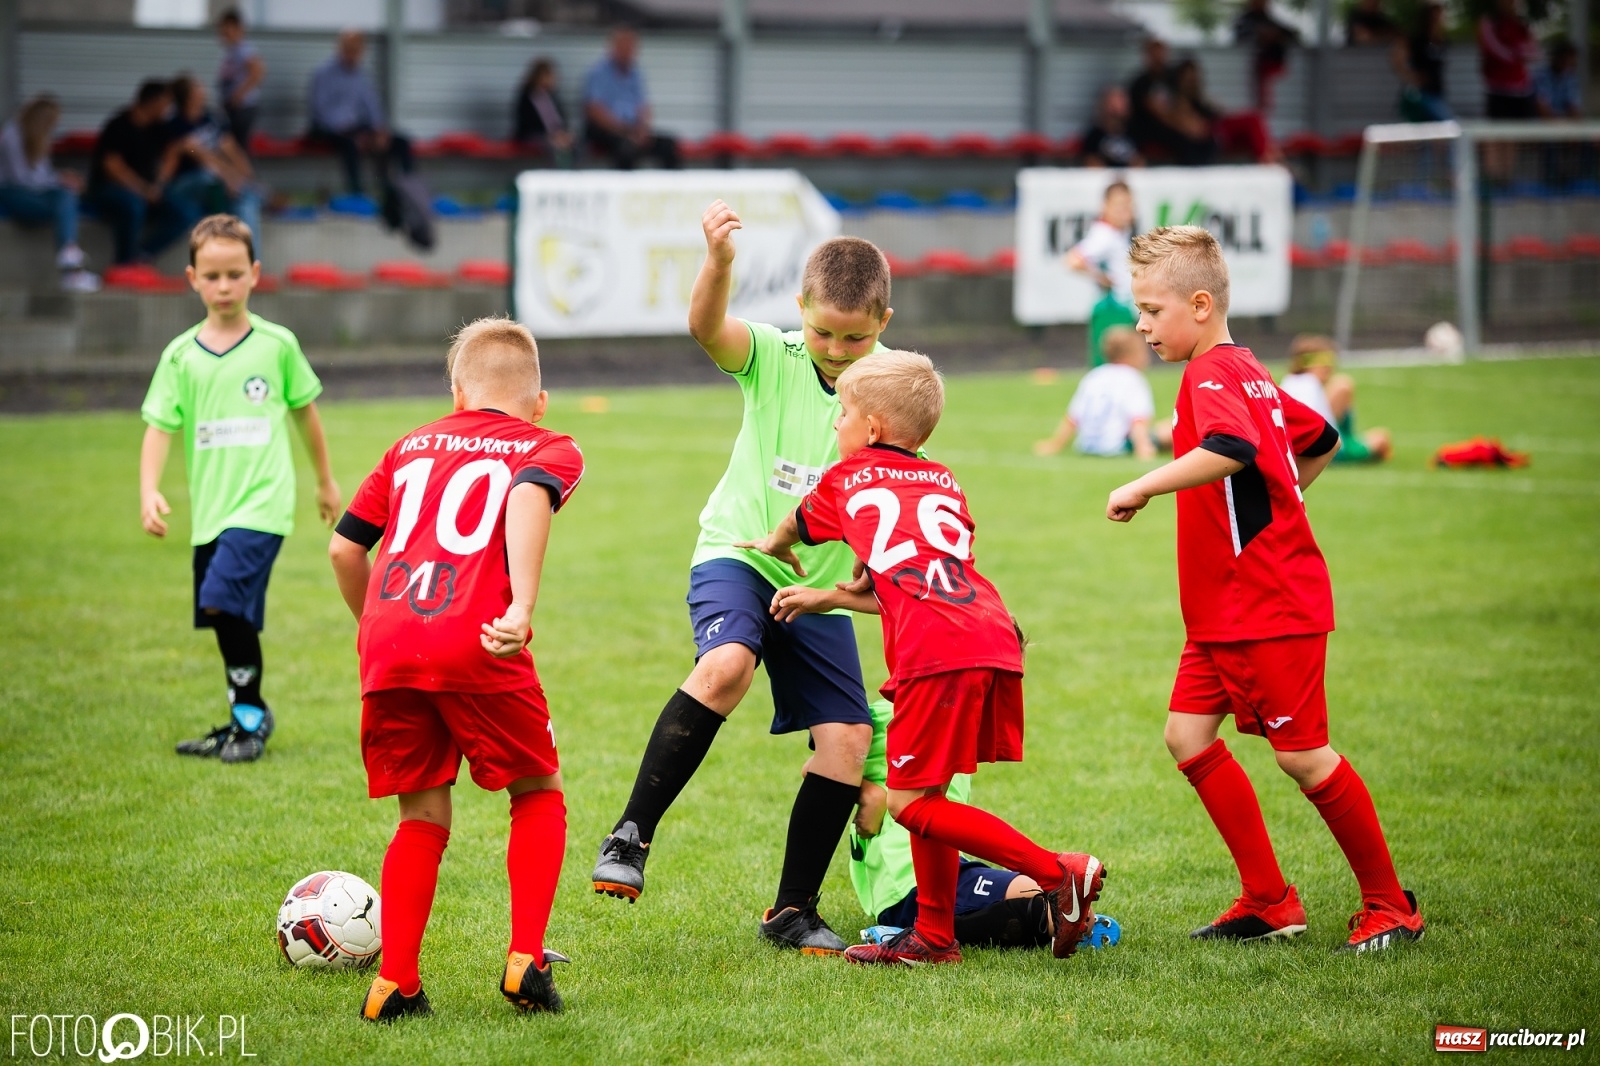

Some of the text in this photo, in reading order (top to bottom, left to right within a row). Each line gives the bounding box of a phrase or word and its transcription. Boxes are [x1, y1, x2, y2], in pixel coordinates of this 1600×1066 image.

[388, 457, 513, 556] 10
[844, 466, 873, 491] LKS
[845, 487, 970, 575] 26
